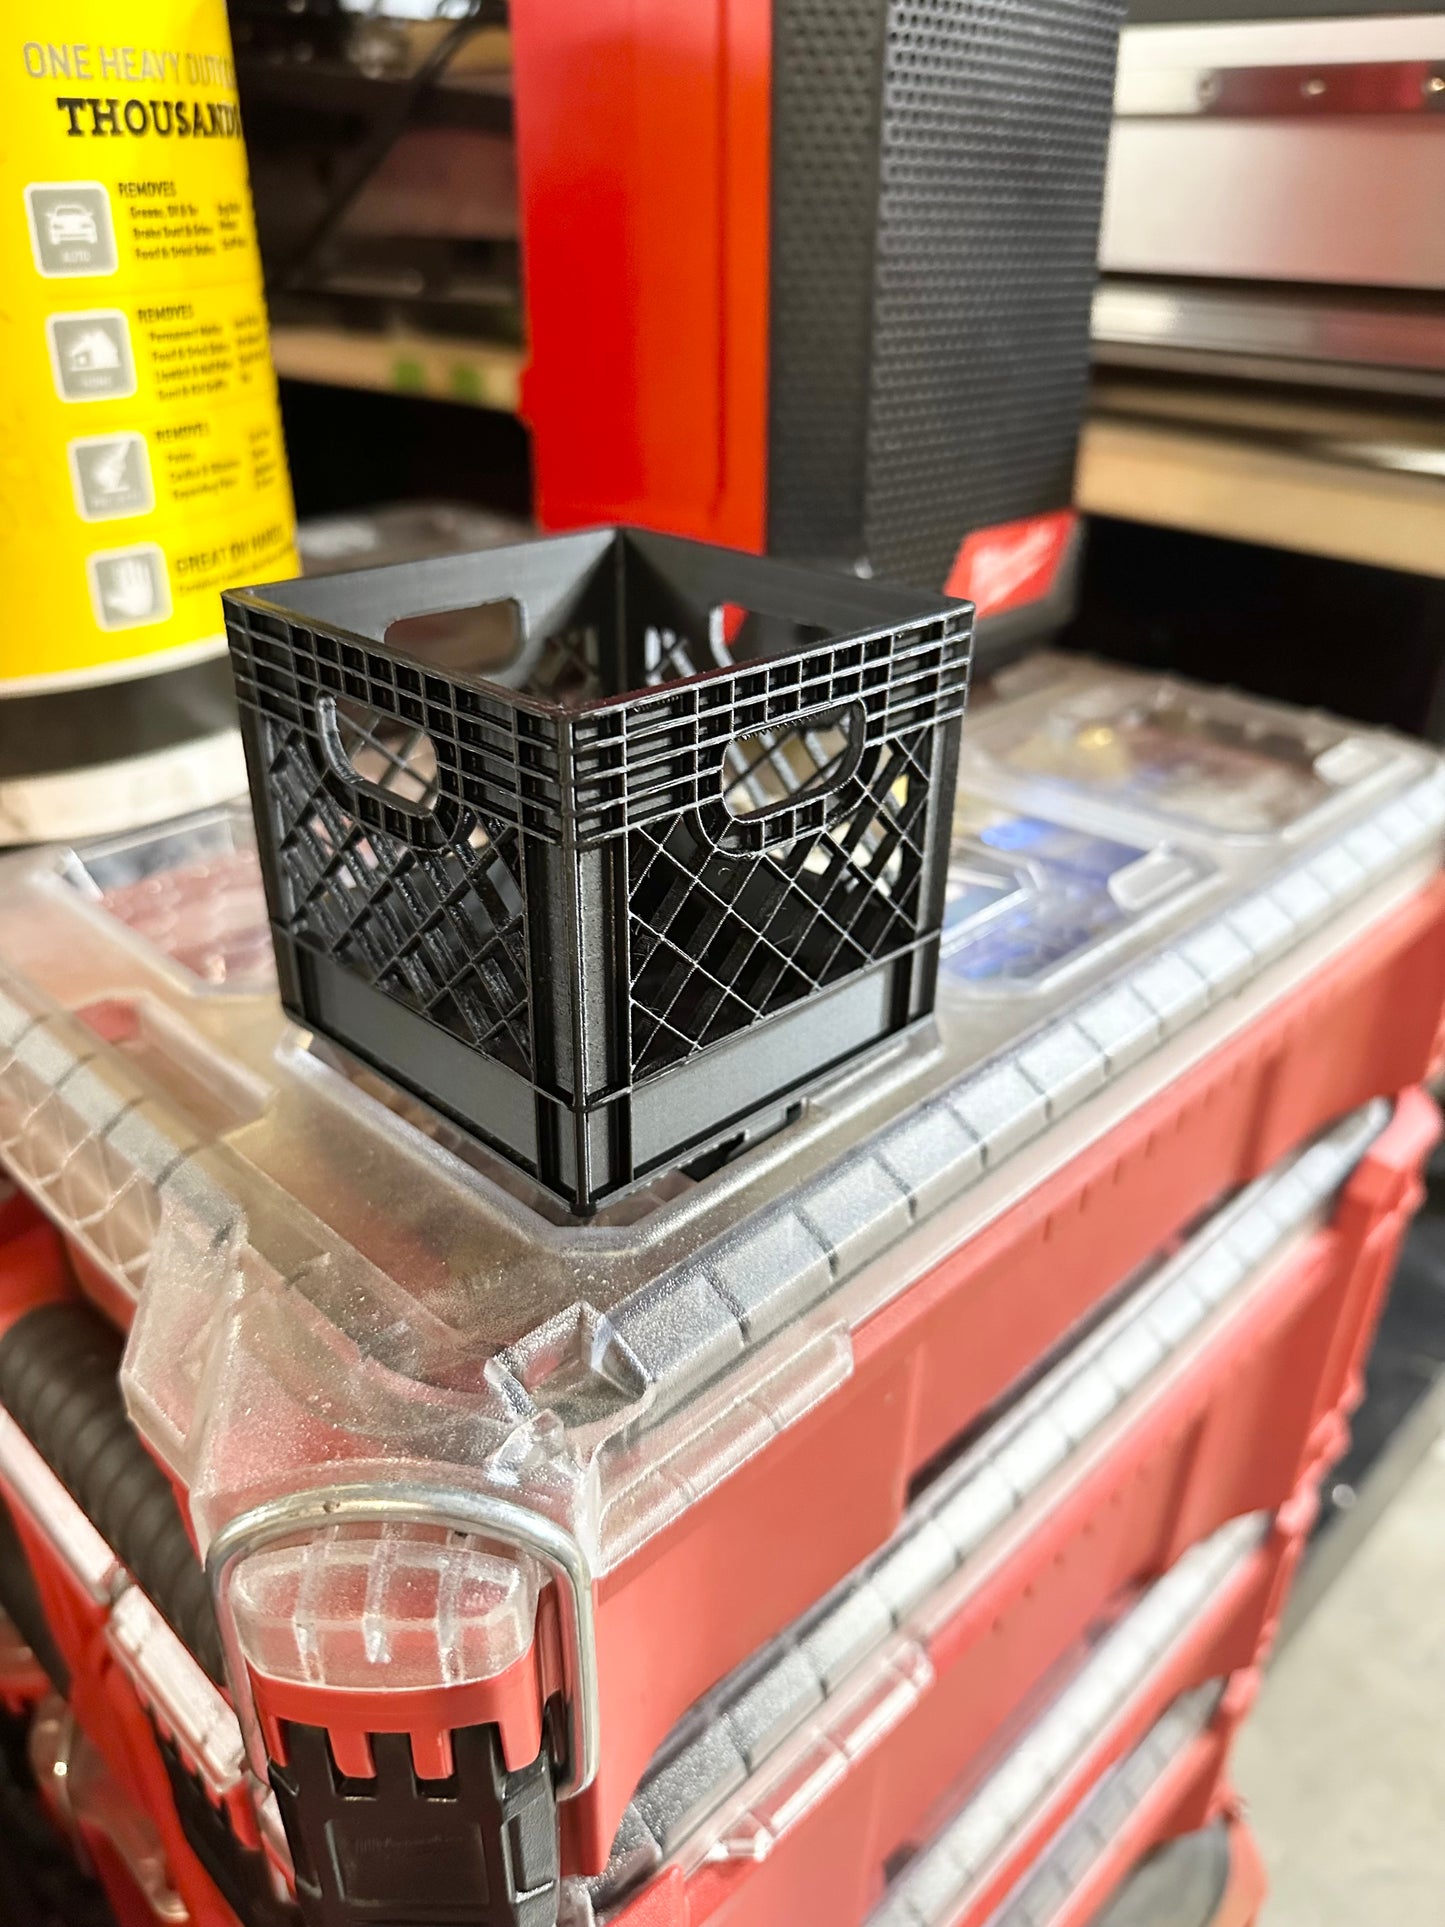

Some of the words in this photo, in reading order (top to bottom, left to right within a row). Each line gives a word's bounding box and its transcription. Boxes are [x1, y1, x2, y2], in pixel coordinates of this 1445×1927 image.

[23, 41, 93, 80] ONE
[99, 46, 180, 85] HEAVY
[118, 181, 177, 198] REMOVES
